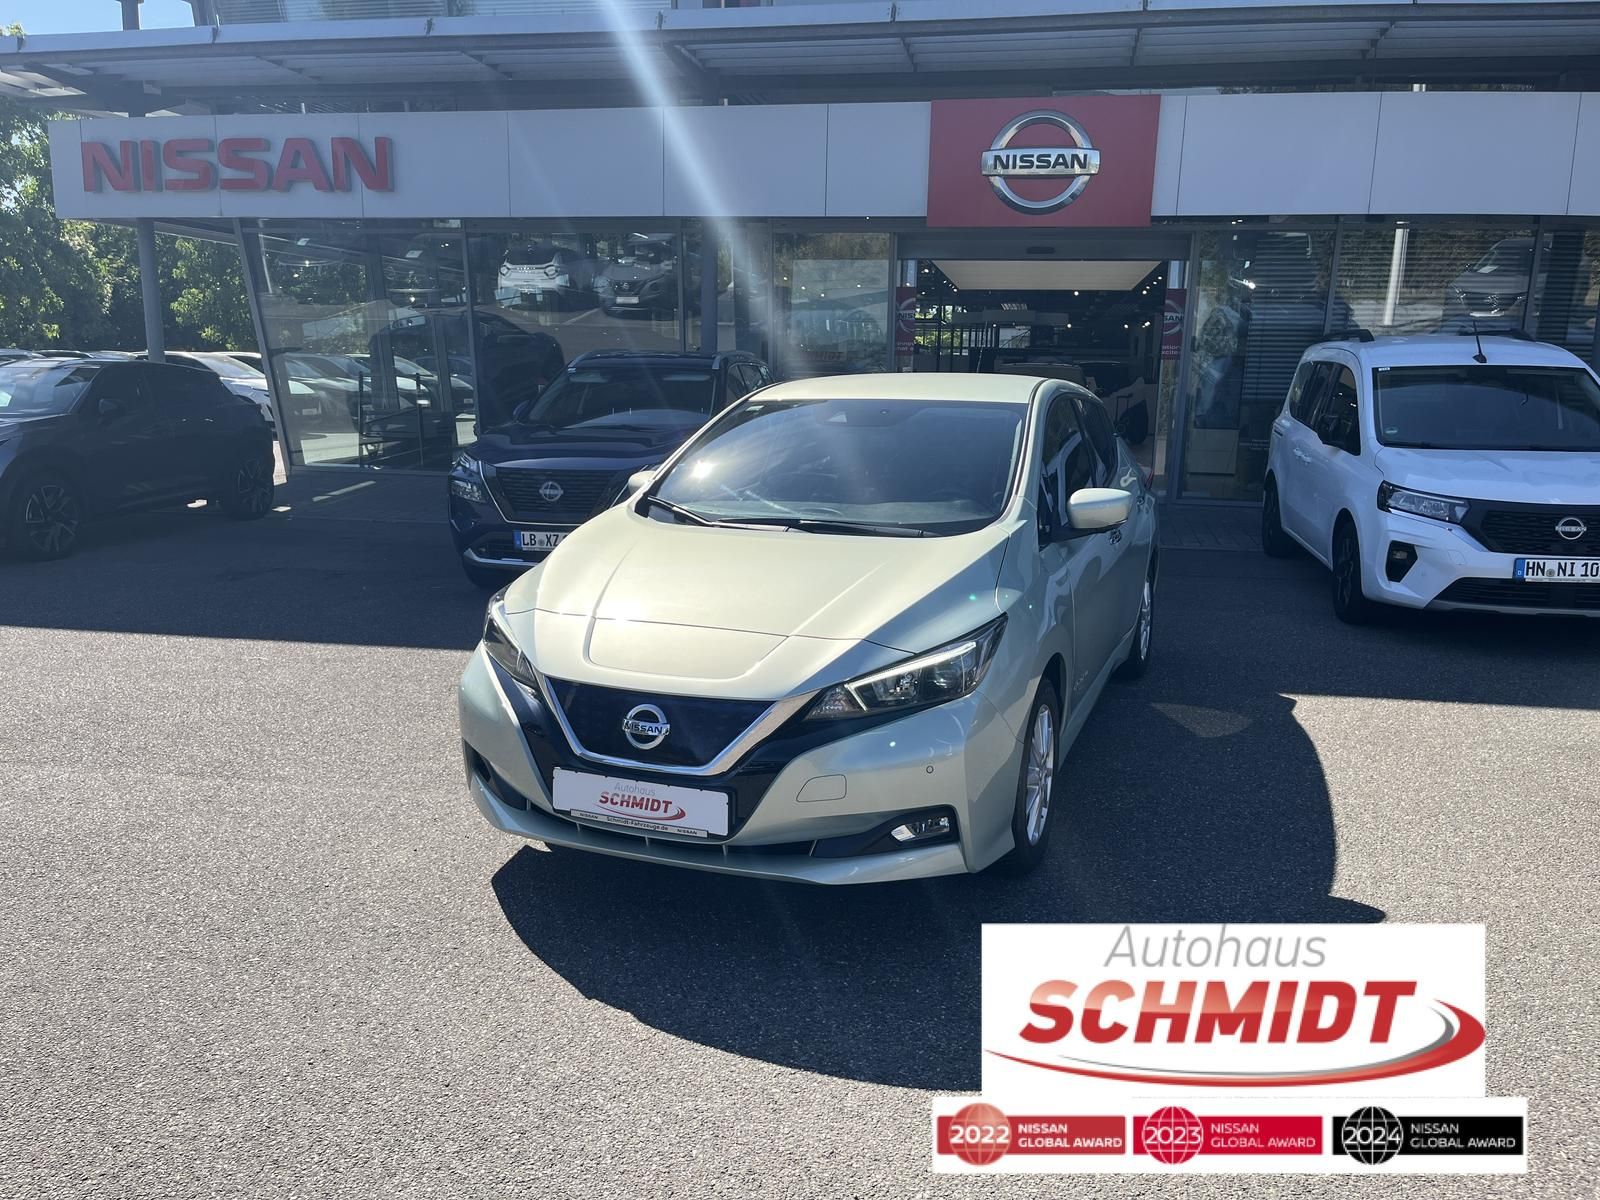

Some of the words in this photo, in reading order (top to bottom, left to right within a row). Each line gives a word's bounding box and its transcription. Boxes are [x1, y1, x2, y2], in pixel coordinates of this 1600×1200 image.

[81, 137, 393, 192] NISSAN
[993, 154, 1088, 170] NISSAN
[522, 533, 537, 546] LB
[545, 534, 559, 547] XZ
[1525, 561, 1546, 577] HN
[1557, 561, 1576, 577] NI
[1580, 562, 1600, 578] 10
[624, 721, 663, 735] NISSAN
[614, 782, 656, 797] Autohaus
[598, 791, 673, 814] SCHMIDT
[606, 816, 669, 831] Schmidt-Fahrzeuge.de
